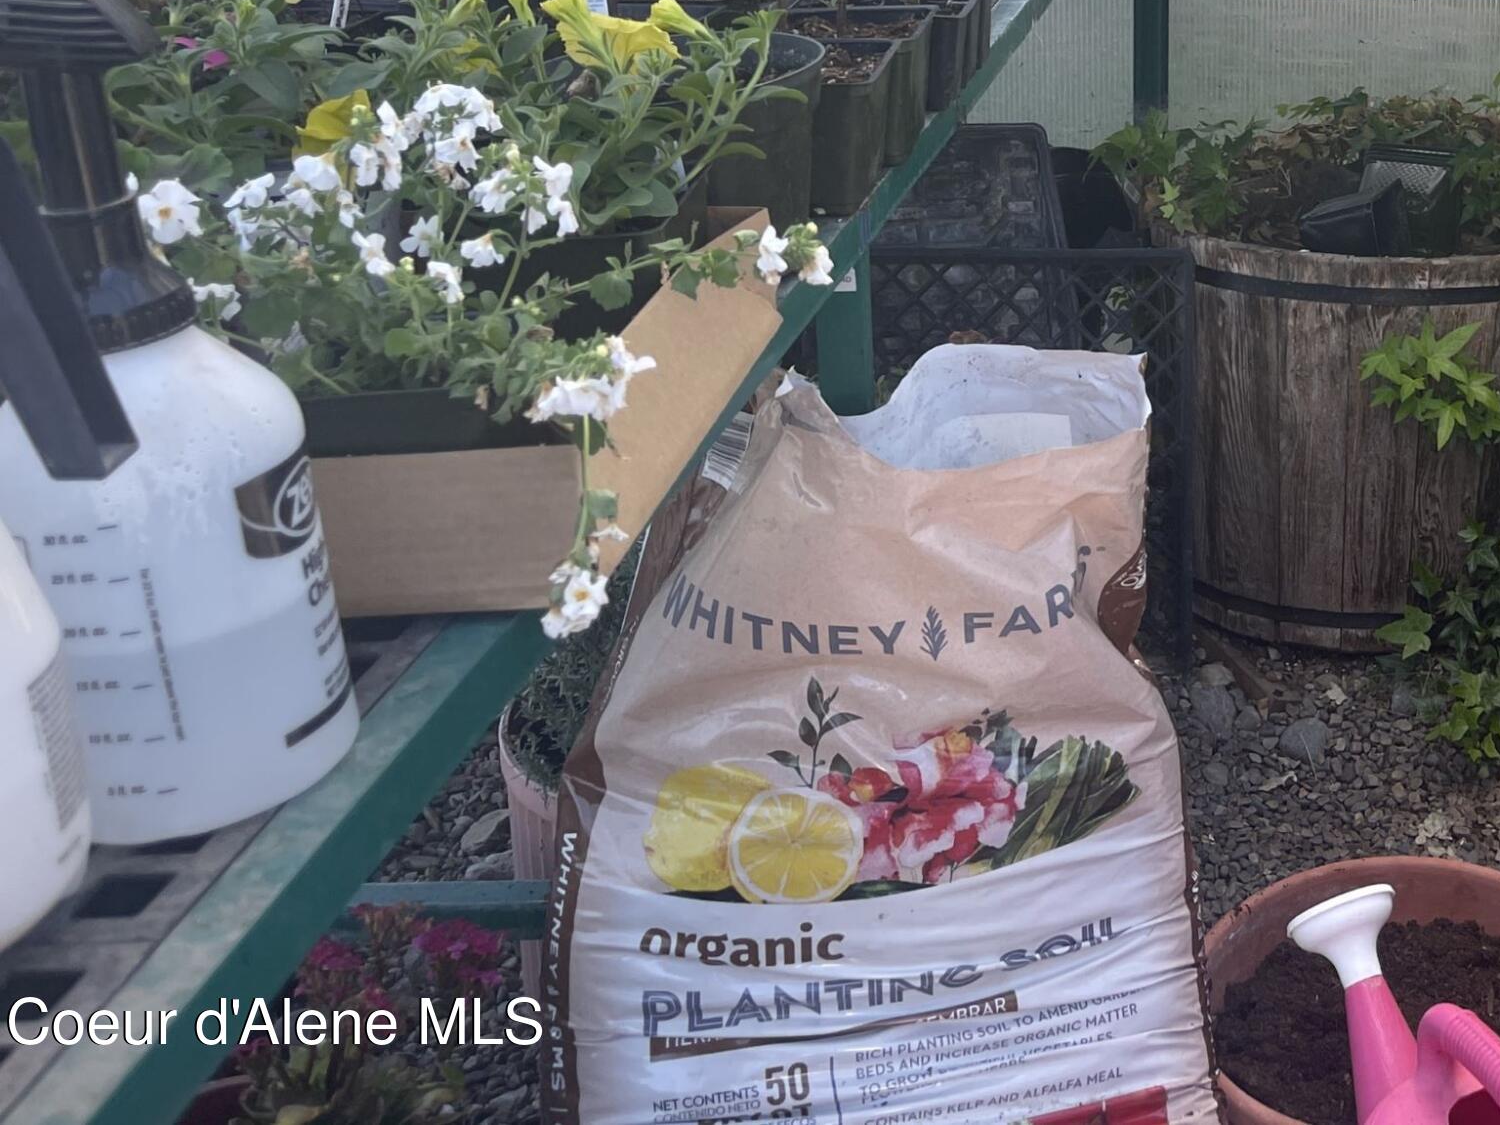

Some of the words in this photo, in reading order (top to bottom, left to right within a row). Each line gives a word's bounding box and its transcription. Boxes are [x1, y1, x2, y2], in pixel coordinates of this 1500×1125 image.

[661, 568, 906, 657] WHITNEY
[549, 832, 578, 979] WHITNEY
[639, 921, 846, 969] organic
[855, 1047, 893, 1063] RICH
[897, 1029, 974, 1056] PLANTING
[976, 1020, 1011, 1039] SOIL
[1013, 1014, 1034, 1028] TO
[1038, 999, 1089, 1023] AMEND
[856, 1061, 895, 1080] BEDS
[899, 1055, 931, 1072] AND
[935, 1037, 1010, 1063] INCREASE
[1013, 1019, 1083, 1045] ORGANIC
[1085, 1002, 1139, 1030] MATTER
[652, 1098, 680, 1113] NET
[682, 1084, 760, 1108] CONTENTS
[727, 1100, 761, 1115] NETO
[764, 1061, 810, 1106] 50
[859, 1082, 881, 1096] TO
[946, 1099, 984, 1114] KELP
[987, 1091, 1019, 1107] AND
[1022, 1077, 1082, 1101] ALFALFA
[1086, 1066, 1124, 1086] MEAL
